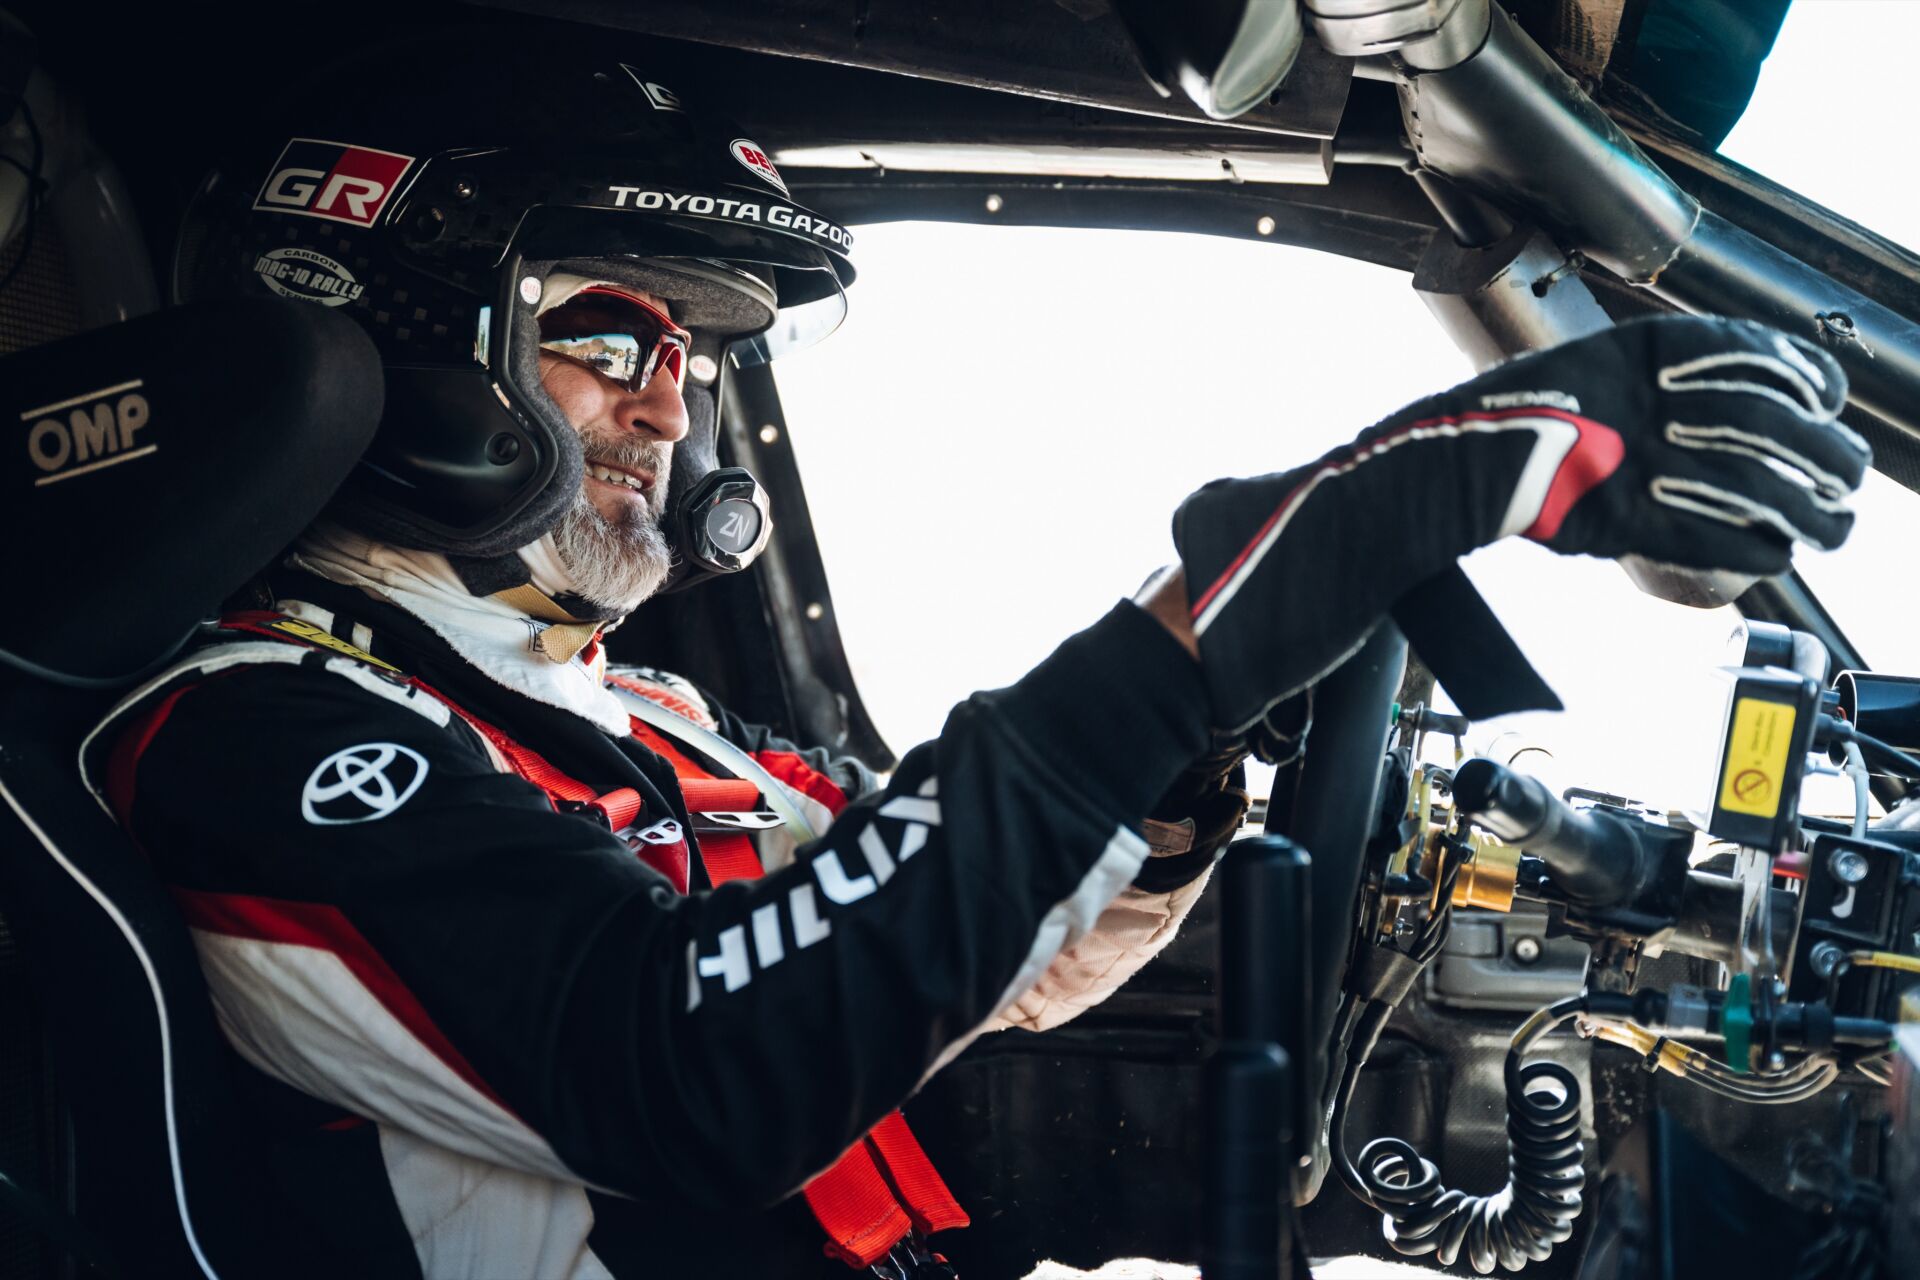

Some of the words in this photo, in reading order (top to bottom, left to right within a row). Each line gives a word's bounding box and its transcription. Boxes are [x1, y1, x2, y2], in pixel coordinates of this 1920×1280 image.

[265, 168, 385, 219] GR
[608, 186, 761, 221] TOYOTA
[767, 206, 852, 250] GAZOO
[254, 256, 311, 285] MAG-10
[309, 273, 364, 300] RALLY
[284, 250, 338, 270] CARBON
[28, 394, 149, 471] OMP
[686, 776, 943, 1014] HILUX
